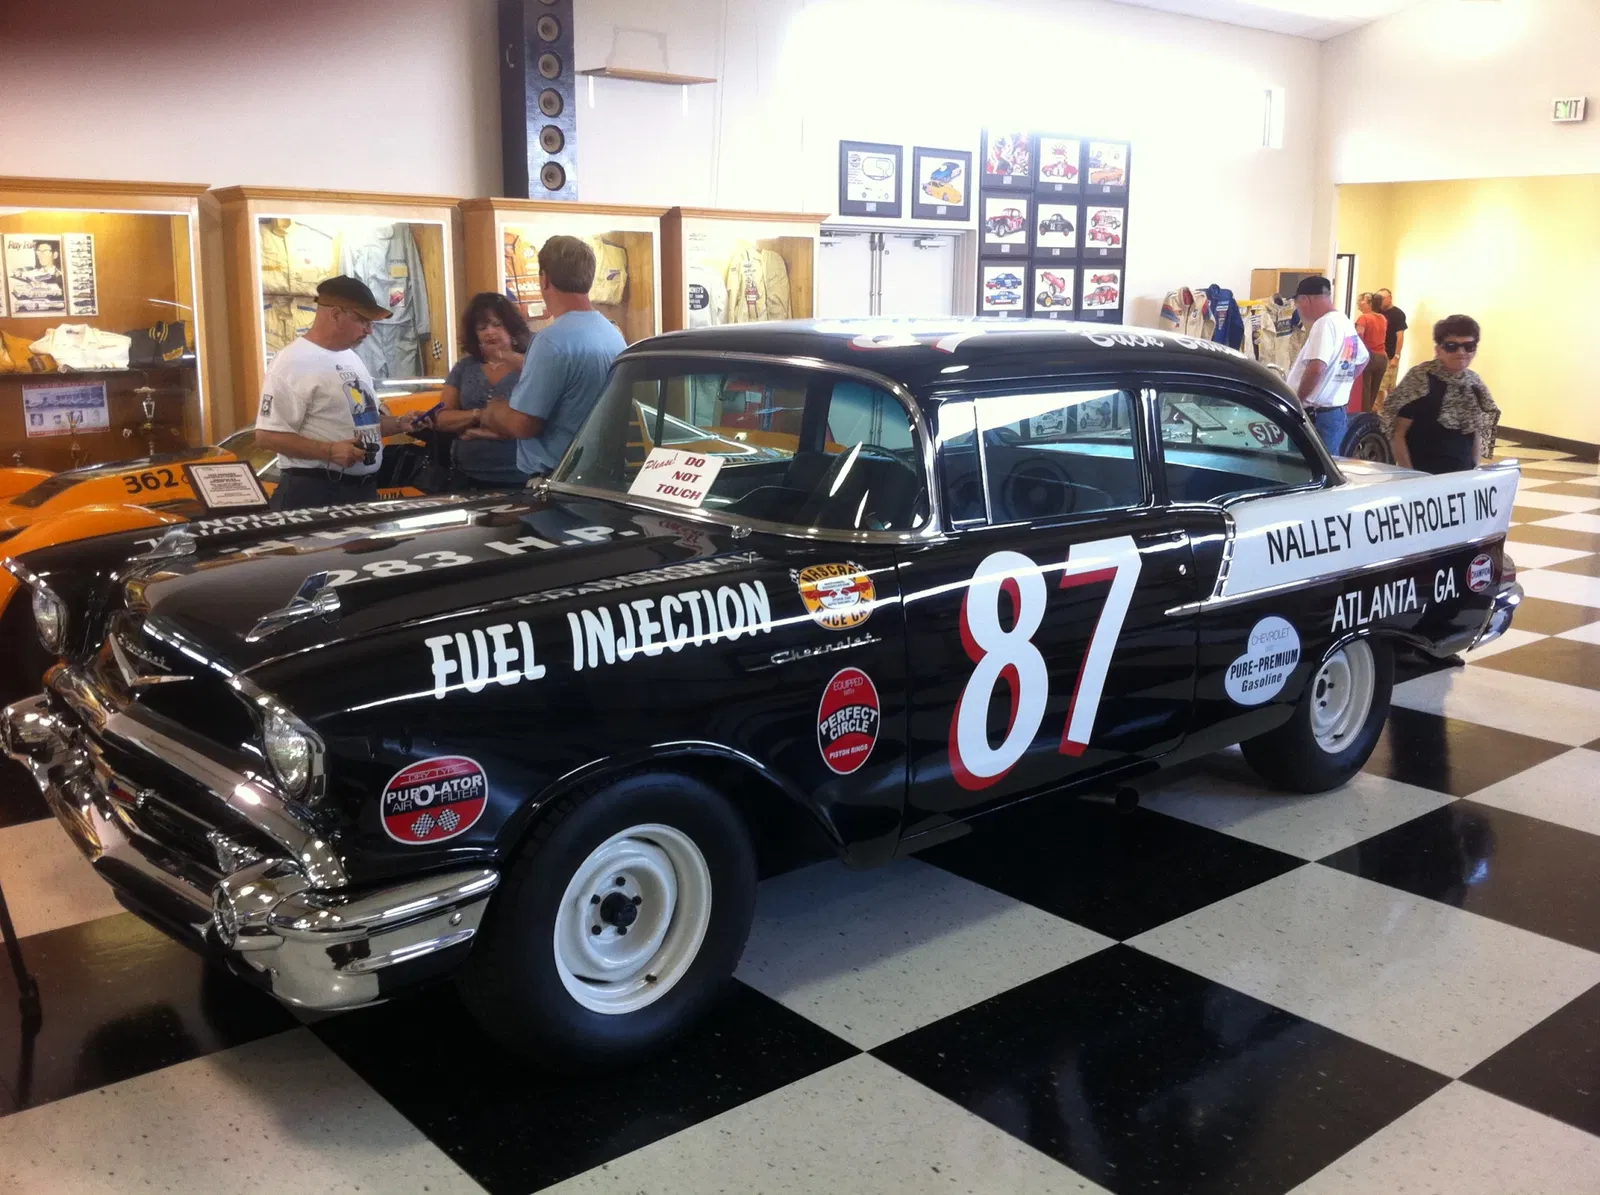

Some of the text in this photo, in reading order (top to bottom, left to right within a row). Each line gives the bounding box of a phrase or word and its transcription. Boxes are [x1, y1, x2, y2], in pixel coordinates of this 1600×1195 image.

[1252, 422, 1281, 443] STP
[644, 453, 678, 471] Please!
[684, 456, 706, 468] DO
[122, 469, 180, 494] 362
[672, 470, 702, 484] NOT
[656, 483, 702, 500] TOUCH
[1266, 486, 1498, 565] NALLEY CHEVROLET INC
[326, 525, 640, 586] 283 H.P.
[1434, 567, 1460, 603] GA.
[425, 580, 772, 700] FUEL INJECTION
[1251, 626, 1291, 646] CHEVROLET
[948, 535, 1143, 791] 87
[1230, 648, 1299, 680] PURE-PREMIUM
[833, 677, 864, 692] EQUIPPED
[1241, 673, 1283, 693] Gasoline
[820, 706, 878, 735] PERFECT
[829, 719, 870, 741] CIRCLE
[829, 743, 868, 760] PISTON RINGS
[392, 787, 479, 813] AIR FILTER
